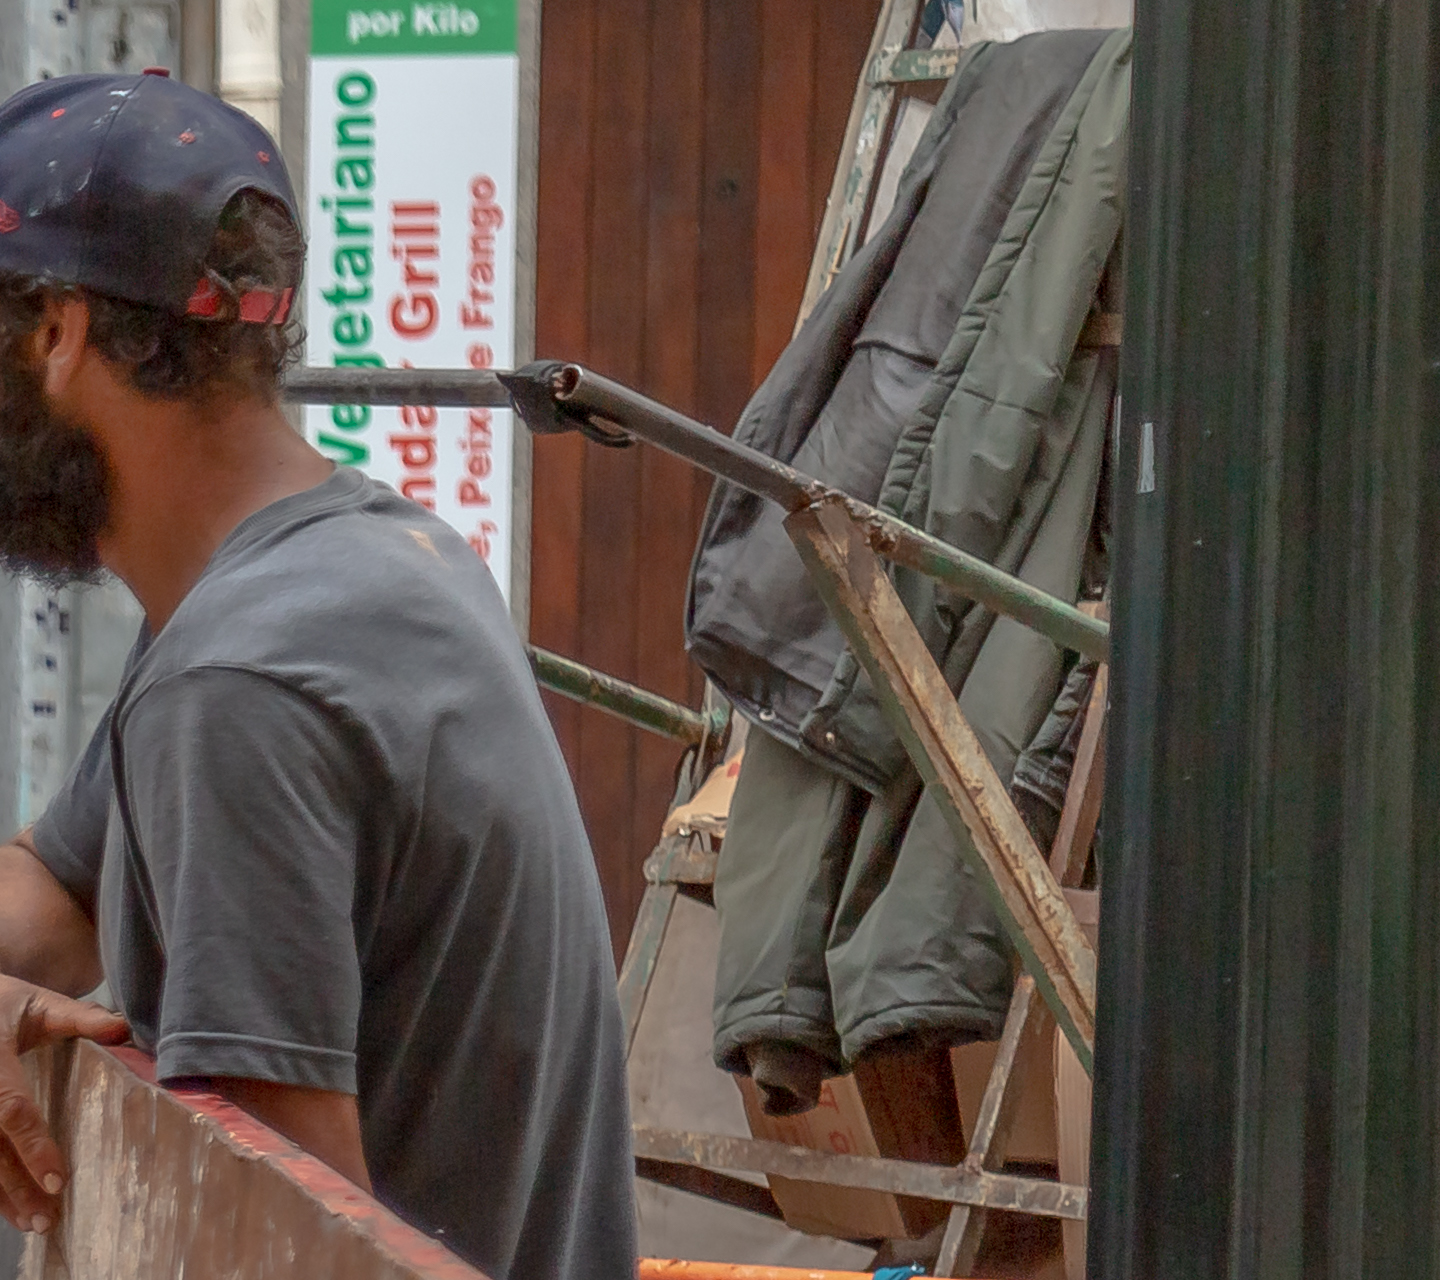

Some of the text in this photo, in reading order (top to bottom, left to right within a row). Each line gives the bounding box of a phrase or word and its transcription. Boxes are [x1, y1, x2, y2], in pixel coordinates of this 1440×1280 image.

[346, 3, 479, 44] por Kilo
[388, 199, 441, 341] Grill
[458, 173, 504, 330] Frango
[457, 406, 492, 507] Peix
